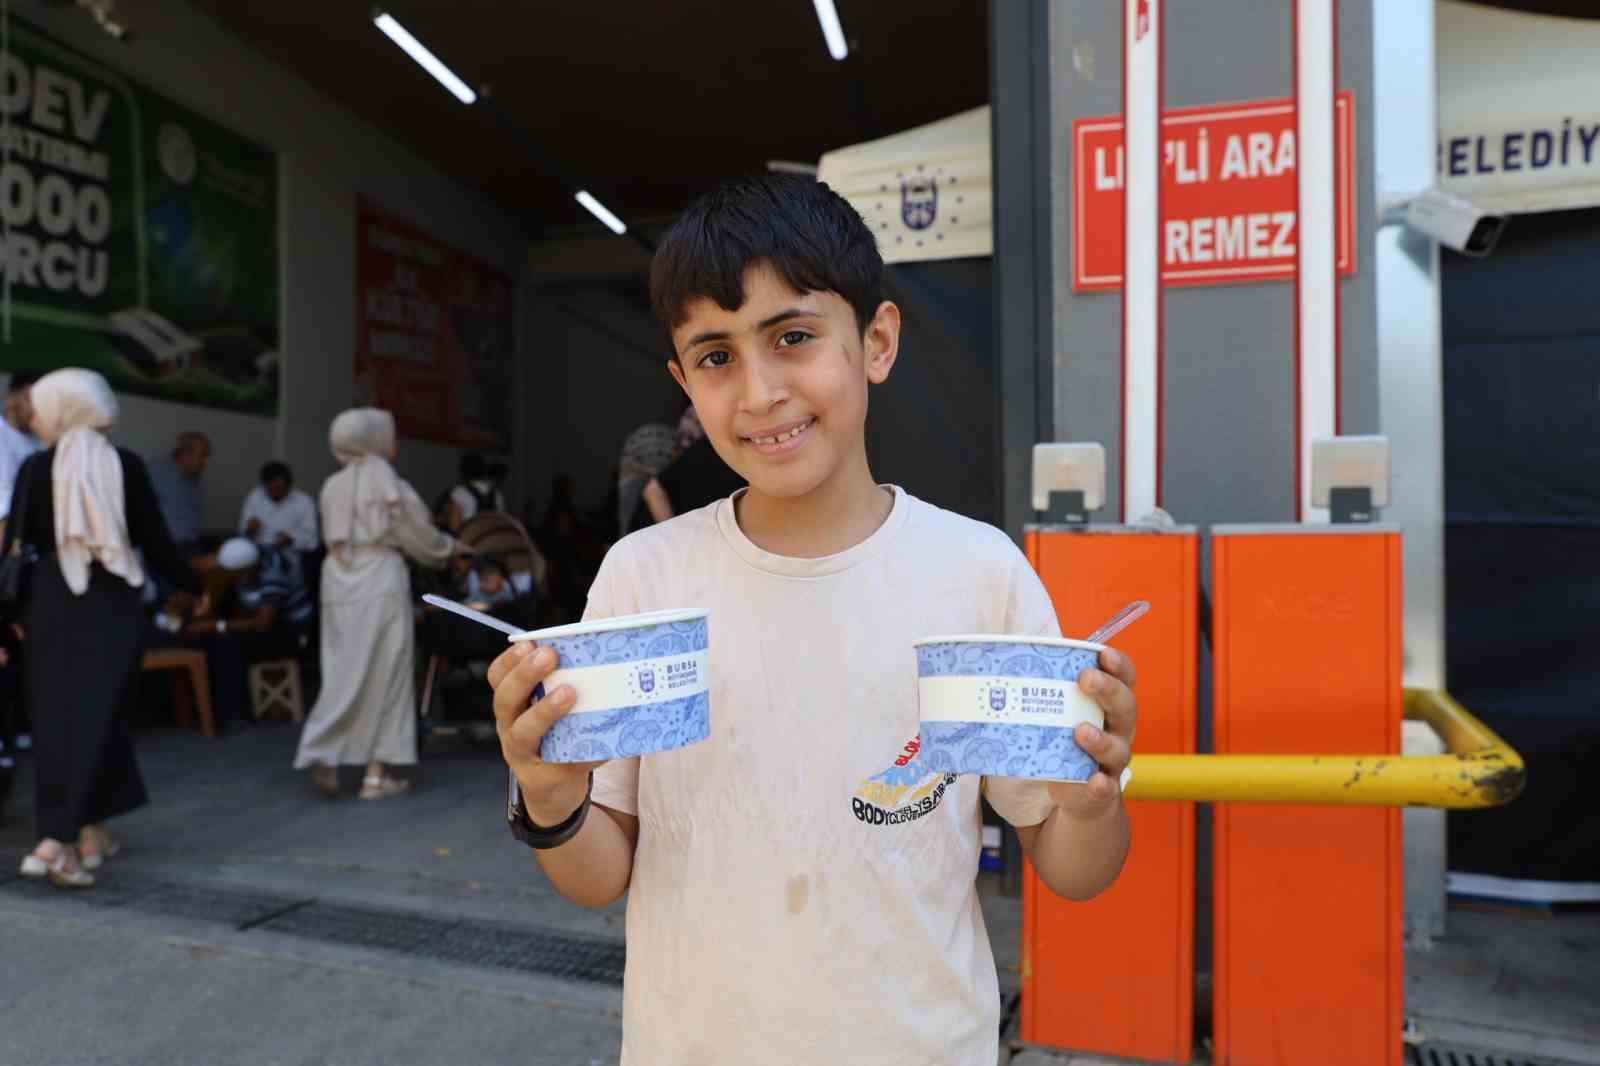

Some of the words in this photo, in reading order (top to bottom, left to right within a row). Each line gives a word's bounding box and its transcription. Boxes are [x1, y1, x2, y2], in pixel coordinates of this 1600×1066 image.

[0, 52, 109, 143] DEV
[1220, 129, 1296, 181] ARA
[1437, 116, 1600, 176] ELEDİY
[0, 231, 108, 296] RCU
[1164, 211, 1296, 263] REMEZ
[1022, 687, 1065, 698] BURSA
